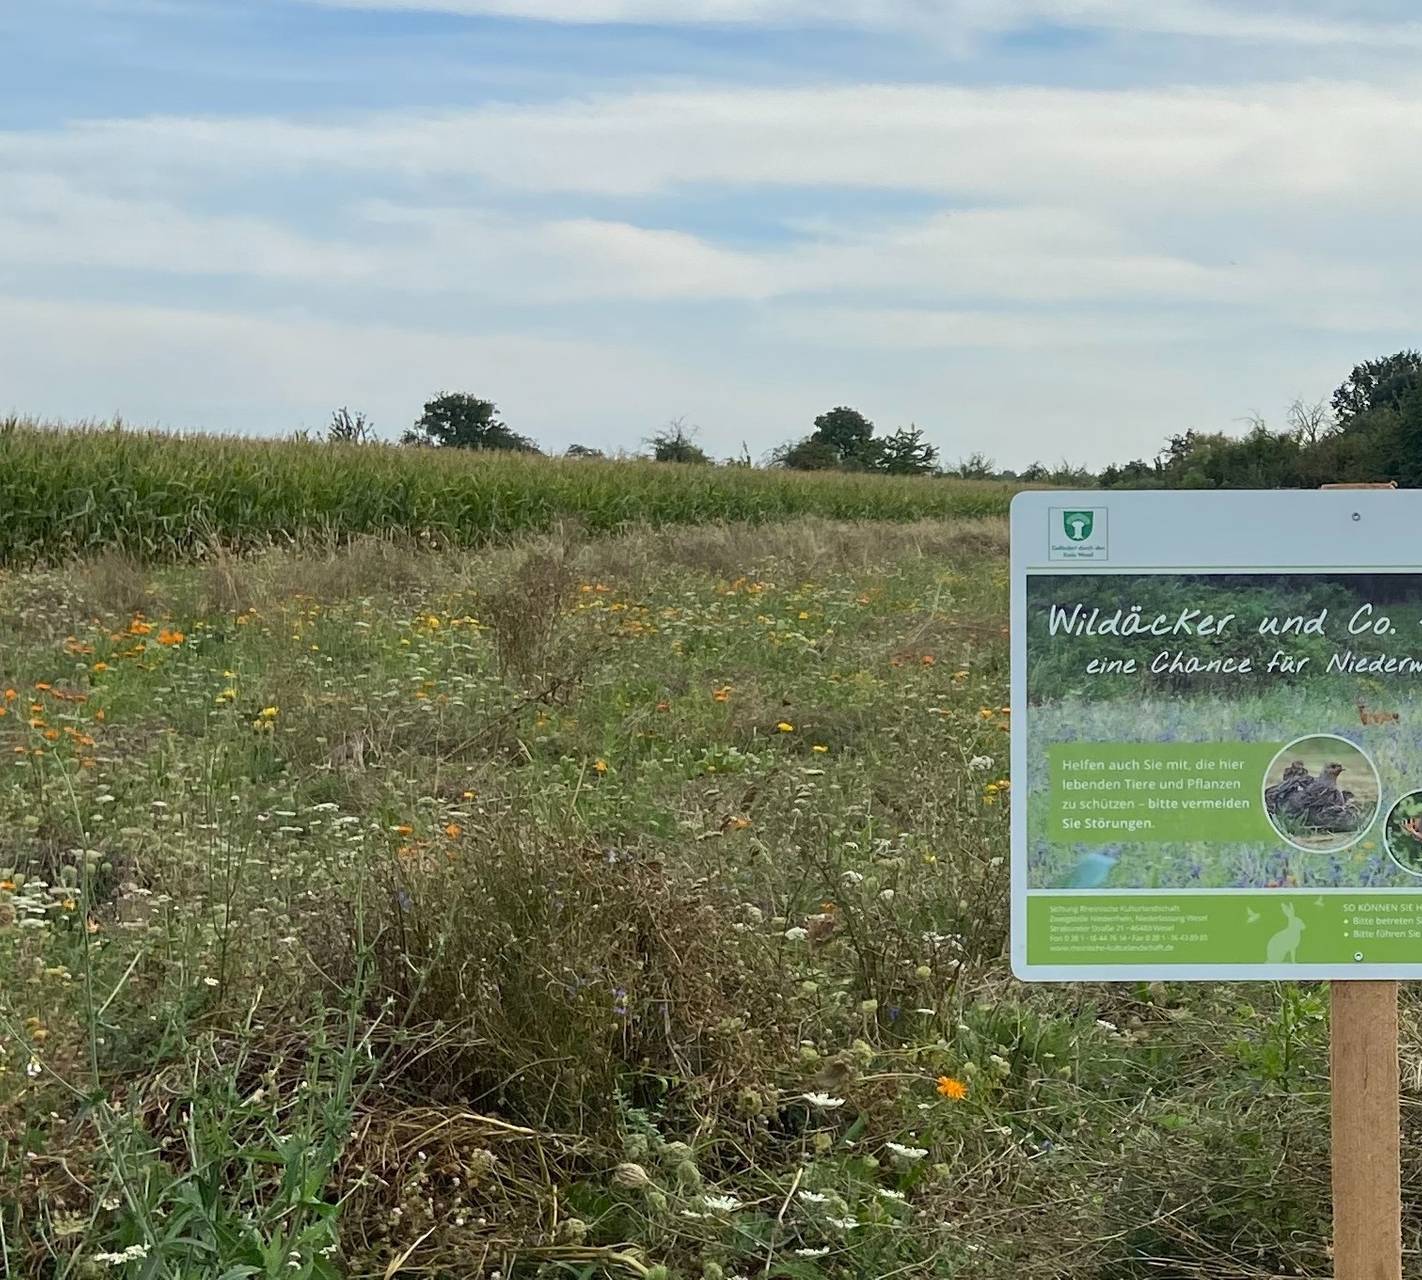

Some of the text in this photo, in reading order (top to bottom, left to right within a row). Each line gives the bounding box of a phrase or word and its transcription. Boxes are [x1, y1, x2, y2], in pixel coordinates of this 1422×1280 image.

[1049, 604, 1235, 636] Wildäcker
[1258, 608, 1328, 636] und
[1347, 603, 1397, 636] Co.
[1086, 655, 1137, 674] eine
[1150, 651, 1252, 673] Chance
[1267, 653, 1310, 673] für
[1062, 759, 1245, 772] Helfen auch Sie mit, die hier
[1062, 778, 1241, 790] lebenden Tiere und Pflanzen
[1062, 801, 1076, 810] zu
[1079, 798, 1135, 810] schützen
[1148, 798, 1178, 809] bitte
[1182, 798, 1250, 809] vermeiden
[1062, 818, 1155, 832] Sie Störungen.
[1343, 904, 1356, 912] SO
[1358, 902, 1397, 912] KÖNNEN
[1399, 903, 1414, 912] SIE
[1353, 917, 1374, 925] Bitte
[1376, 917, 1414, 925] betreten
[1353, 930, 1374, 938] Bitte
[1376, 930, 1406, 938] führen
[1408, 930, 1421, 938] Sie
